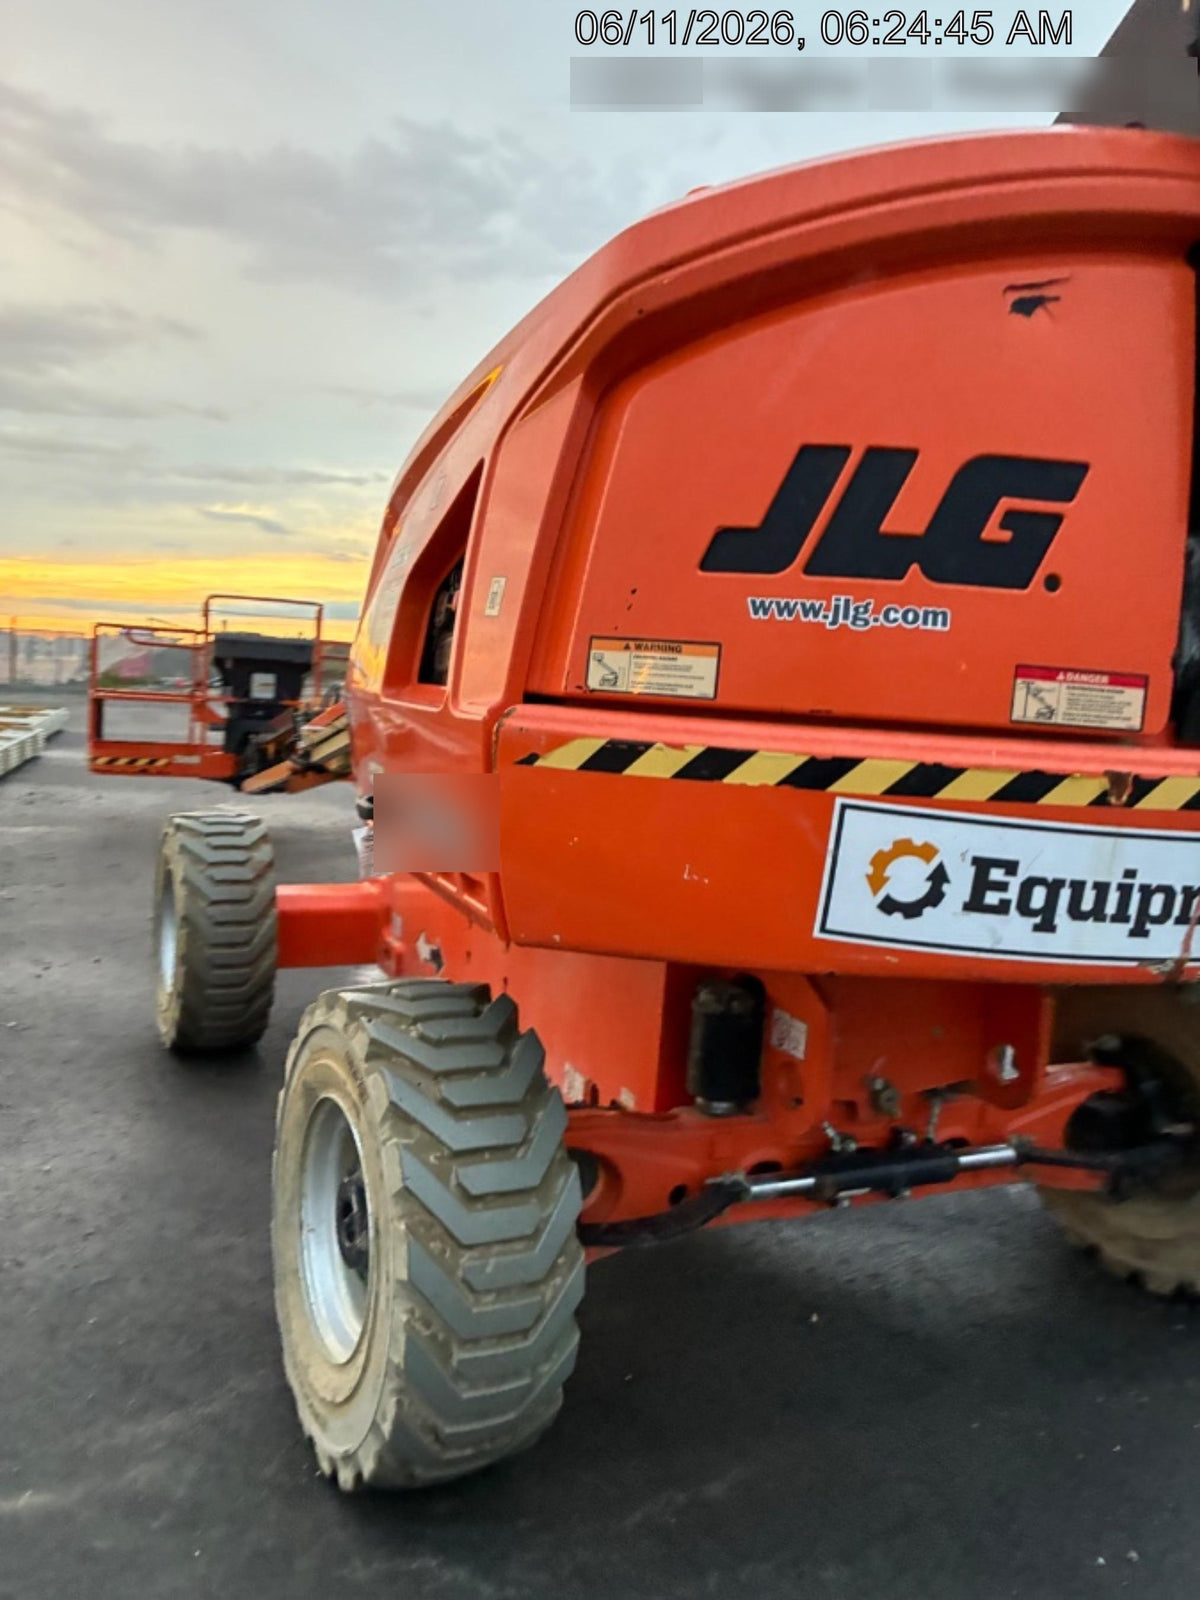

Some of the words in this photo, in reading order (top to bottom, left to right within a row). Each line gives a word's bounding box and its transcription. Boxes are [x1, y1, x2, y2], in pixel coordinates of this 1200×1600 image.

[748, 596, 951, 631] www.jlg.com
[634, 642, 683, 653] WARNING
[1065, 671, 1110, 684] DANGER
